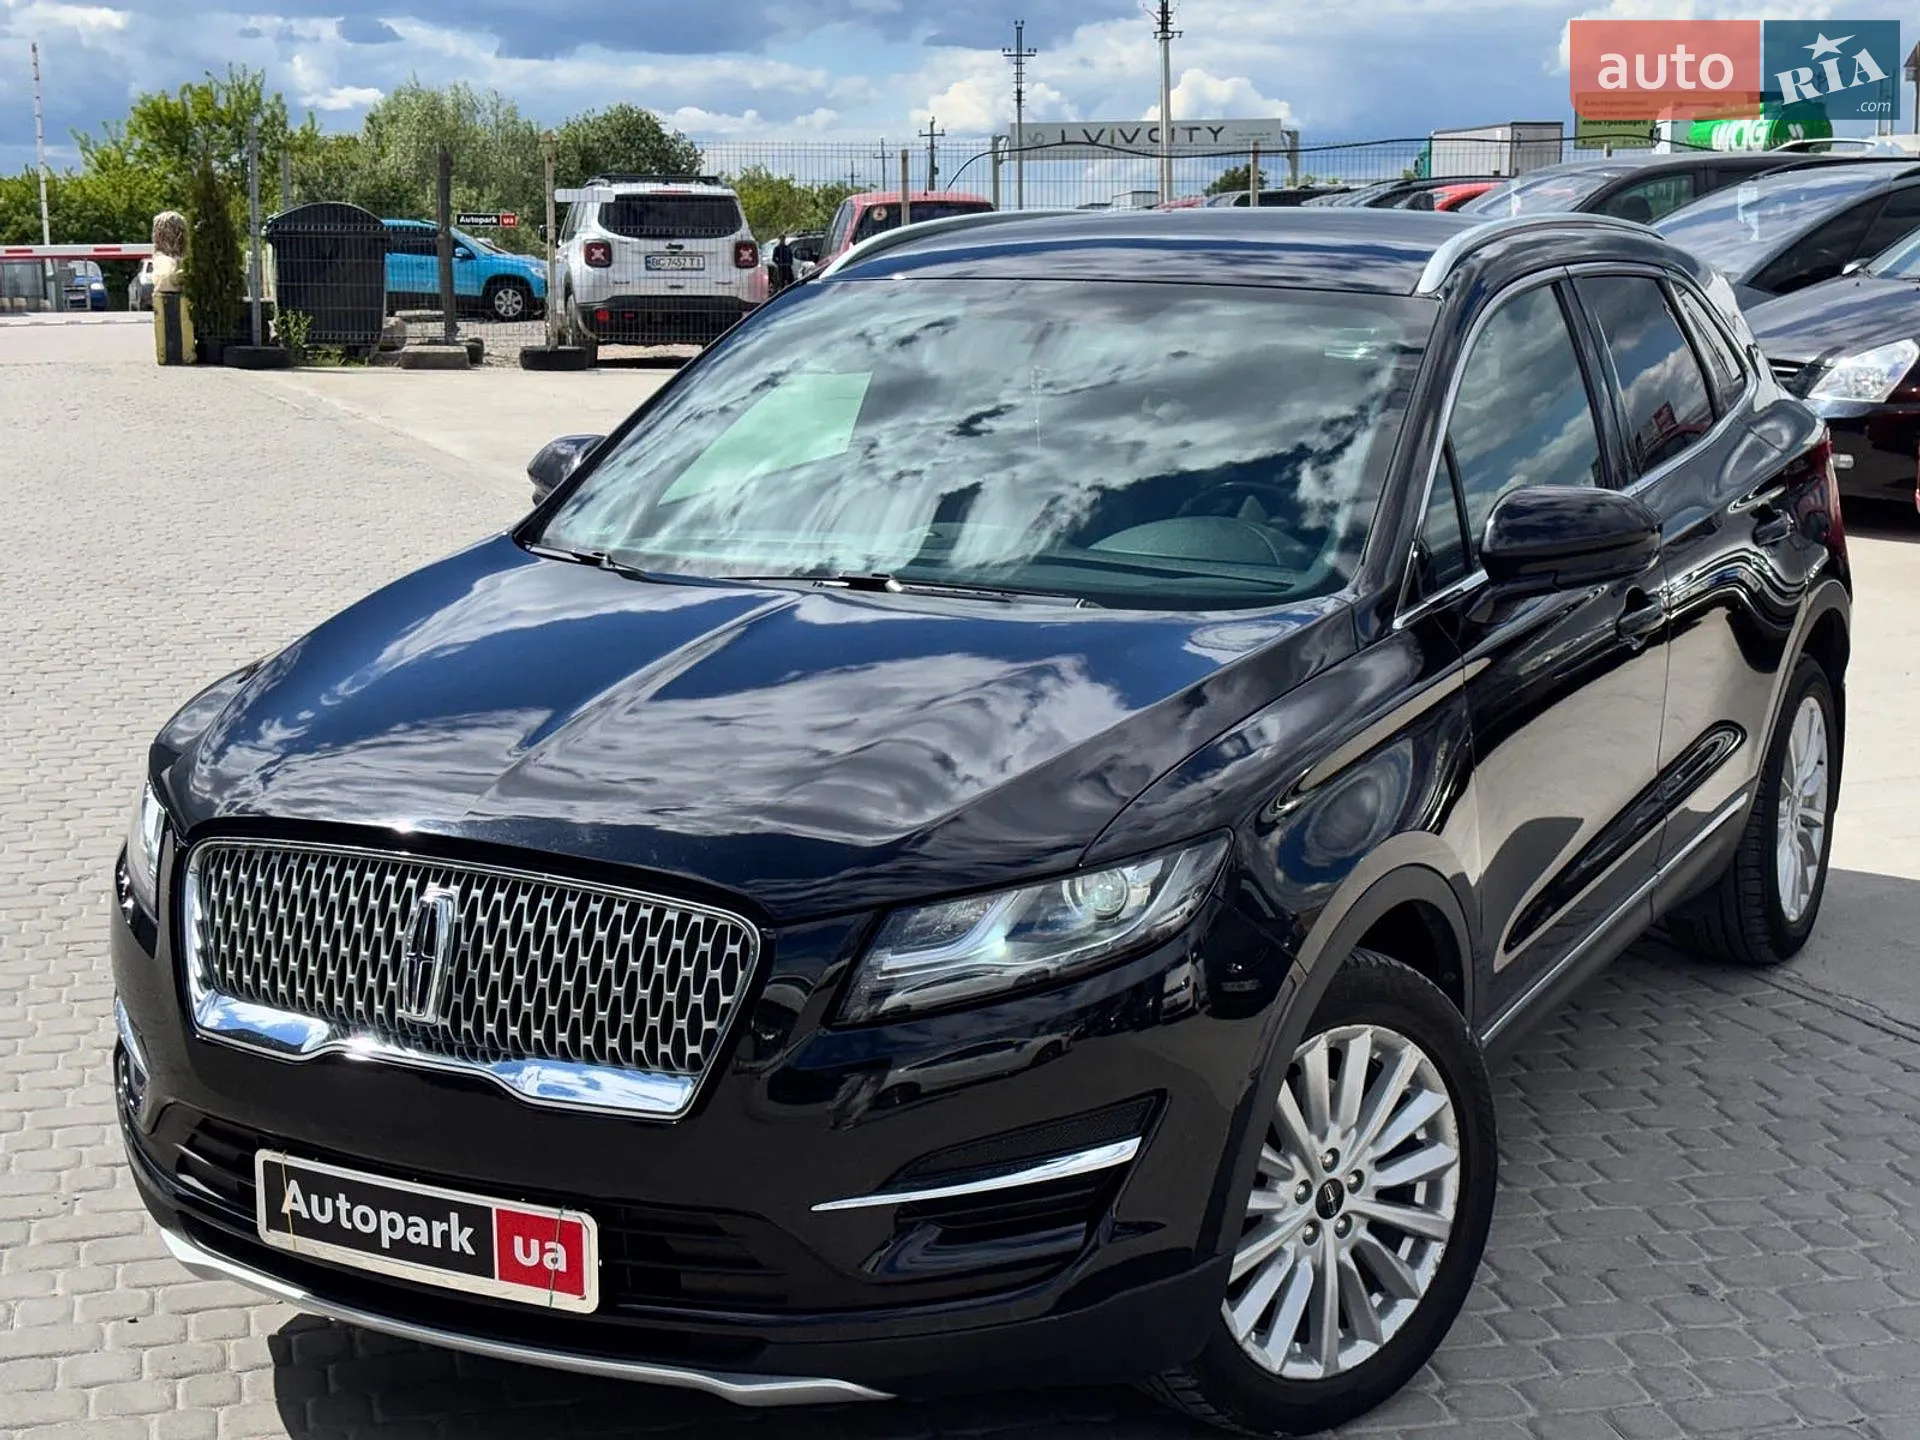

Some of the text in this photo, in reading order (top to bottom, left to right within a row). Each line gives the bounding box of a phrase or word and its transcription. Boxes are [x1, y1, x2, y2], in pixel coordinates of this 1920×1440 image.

[460, 215, 497, 224] Autopark
[281, 1179, 568, 1273] Autopark ua
